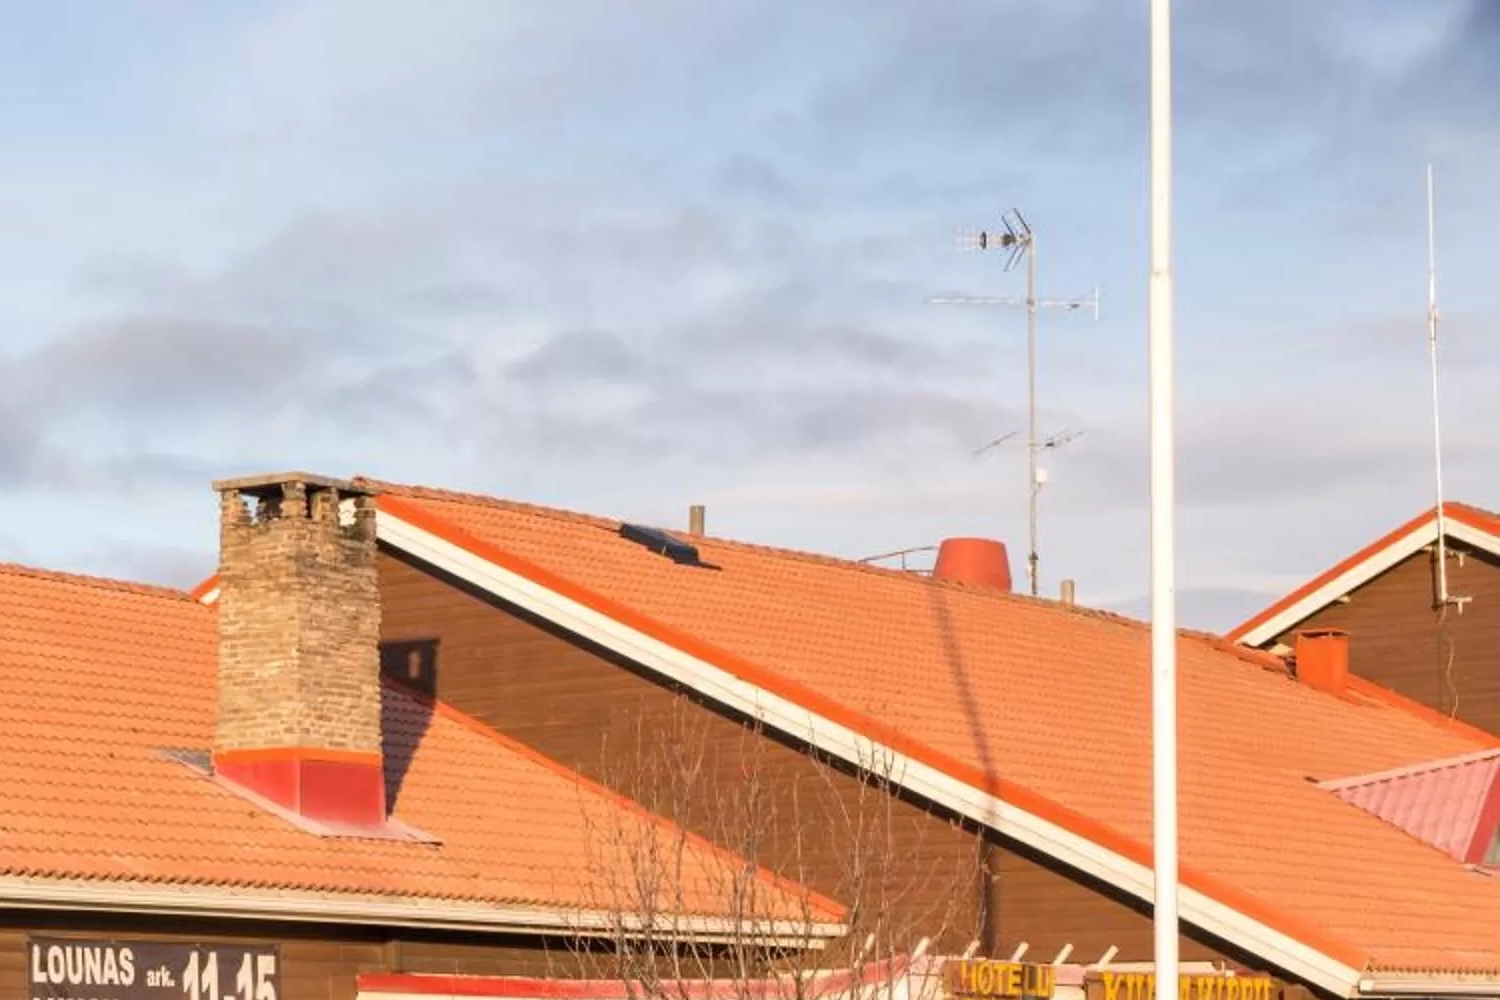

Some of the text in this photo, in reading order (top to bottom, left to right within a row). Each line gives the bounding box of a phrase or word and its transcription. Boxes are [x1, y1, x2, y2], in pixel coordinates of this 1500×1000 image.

[32, 944, 176, 988] LOUNAS ark.
[961, 960, 1055, 996] HOTELLI
